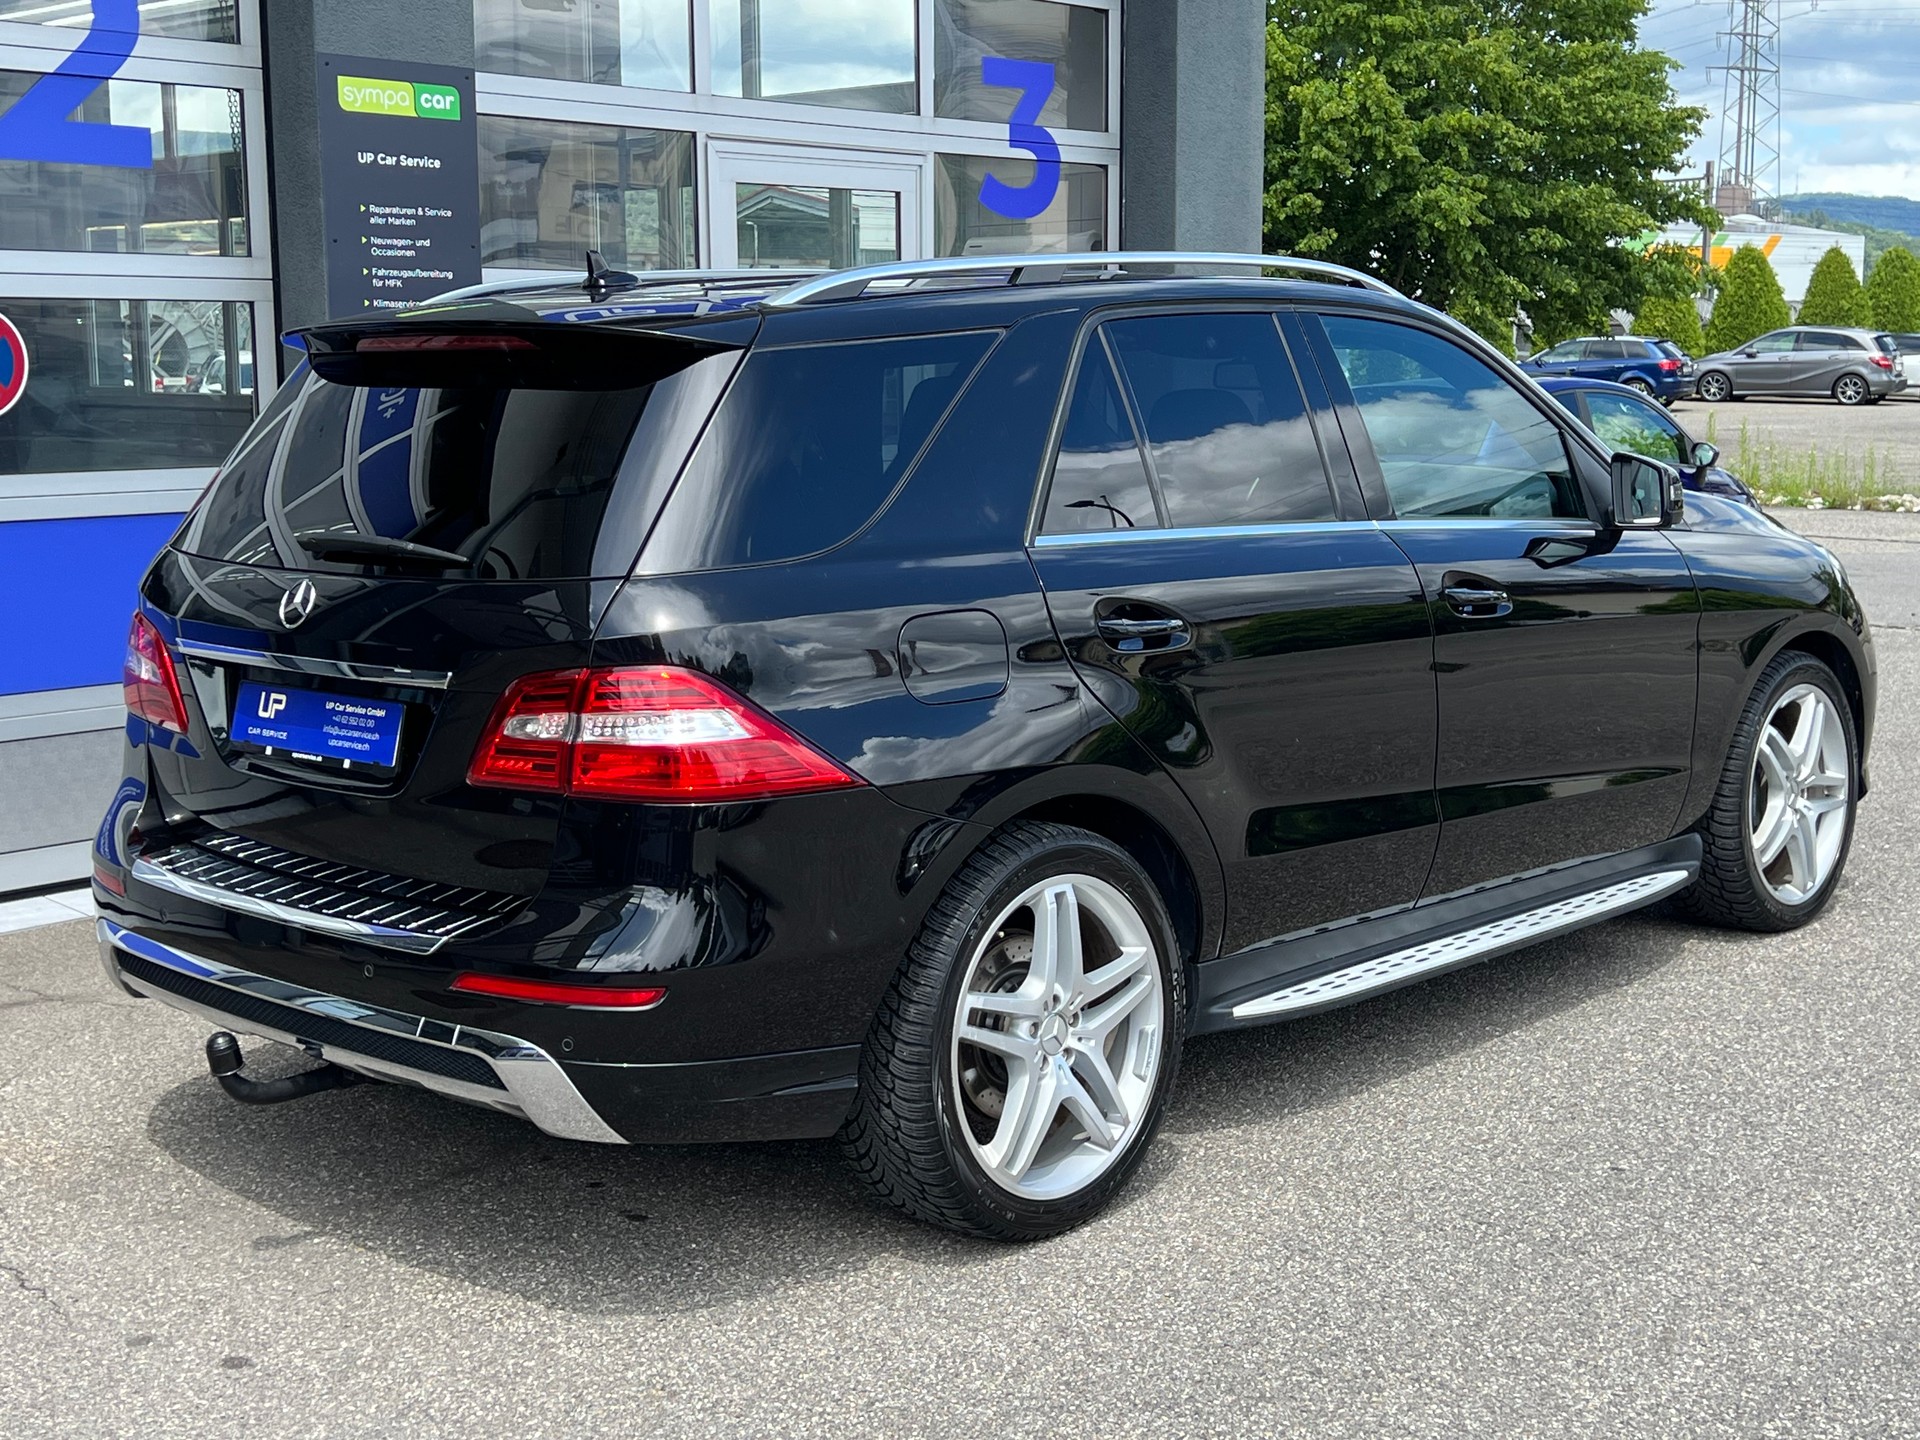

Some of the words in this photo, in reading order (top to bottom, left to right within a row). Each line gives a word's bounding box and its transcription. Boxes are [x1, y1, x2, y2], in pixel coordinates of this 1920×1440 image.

[343, 85, 410, 110] sympa
[420, 93, 455, 110] car
[979, 56, 1061, 219] 3
[357, 151, 375, 164] UP
[377, 153, 397, 166] Car
[400, 155, 441, 168] Service
[369, 205, 416, 217] Reparaturen
[417, 207, 424, 216] &
[424, 207, 452, 217] Service
[369, 216, 386, 225] aller
[388, 217, 416, 226] Marken
[370, 237, 414, 248] Neuwagen-
[415, 238, 430, 247] und
[371, 247, 416, 257] Occasionen
[372, 268, 453, 279] Fahrzeugaufbereitung
[372, 278, 385, 287] für
[386, 279, 403, 288] MFK
[258, 691, 287, 719] UP
[325, 701, 334, 710] UP
[334, 702, 345, 712] Car
[345, 704, 367, 715] Service
[367, 707, 386, 718] GmbH
[248, 726, 261, 736] CAR
[262, 728, 288, 740] SERVICE
[322, 724, 380, 741] info@upcarservice.ch
[328, 738, 371, 751] upcarservice.ch
